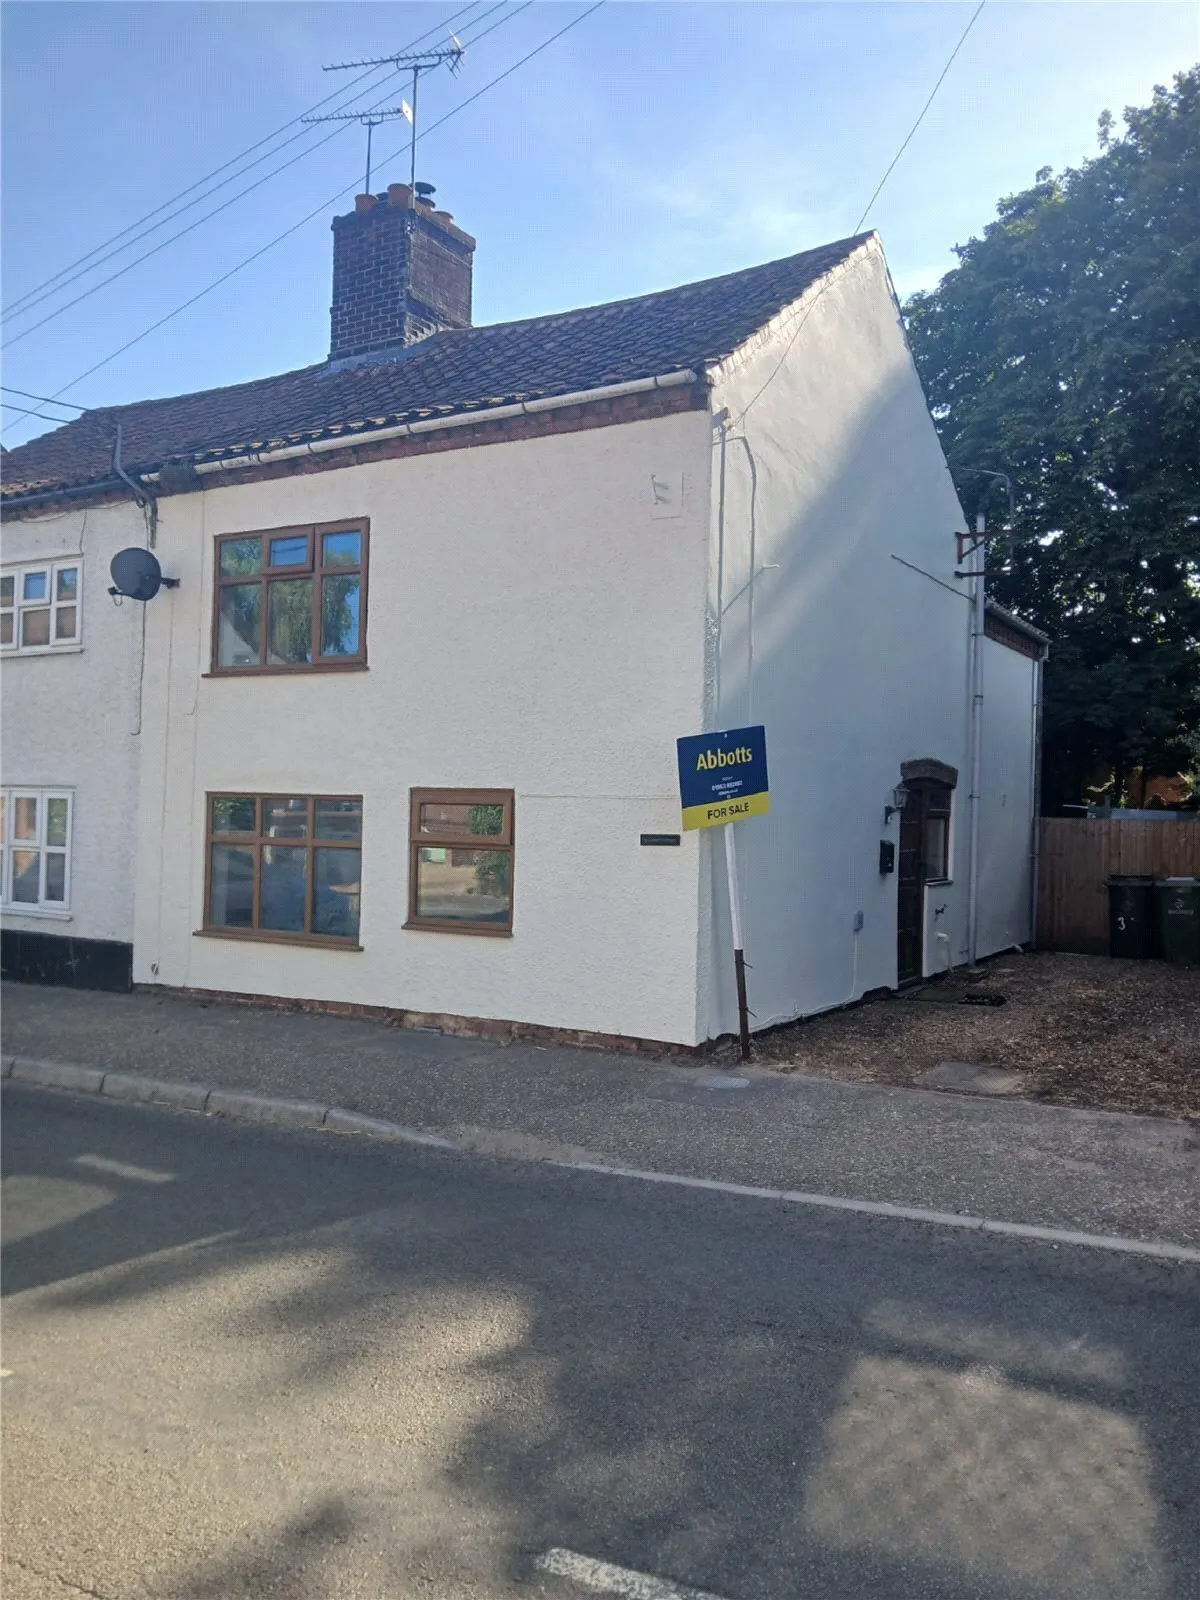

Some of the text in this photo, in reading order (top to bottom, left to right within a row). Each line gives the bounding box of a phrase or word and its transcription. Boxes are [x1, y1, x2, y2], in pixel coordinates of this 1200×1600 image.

[696, 747, 752, 771] Abbotts
[707, 802, 749, 820] FOR SALE
[1117, 916, 1126, 931] 3
